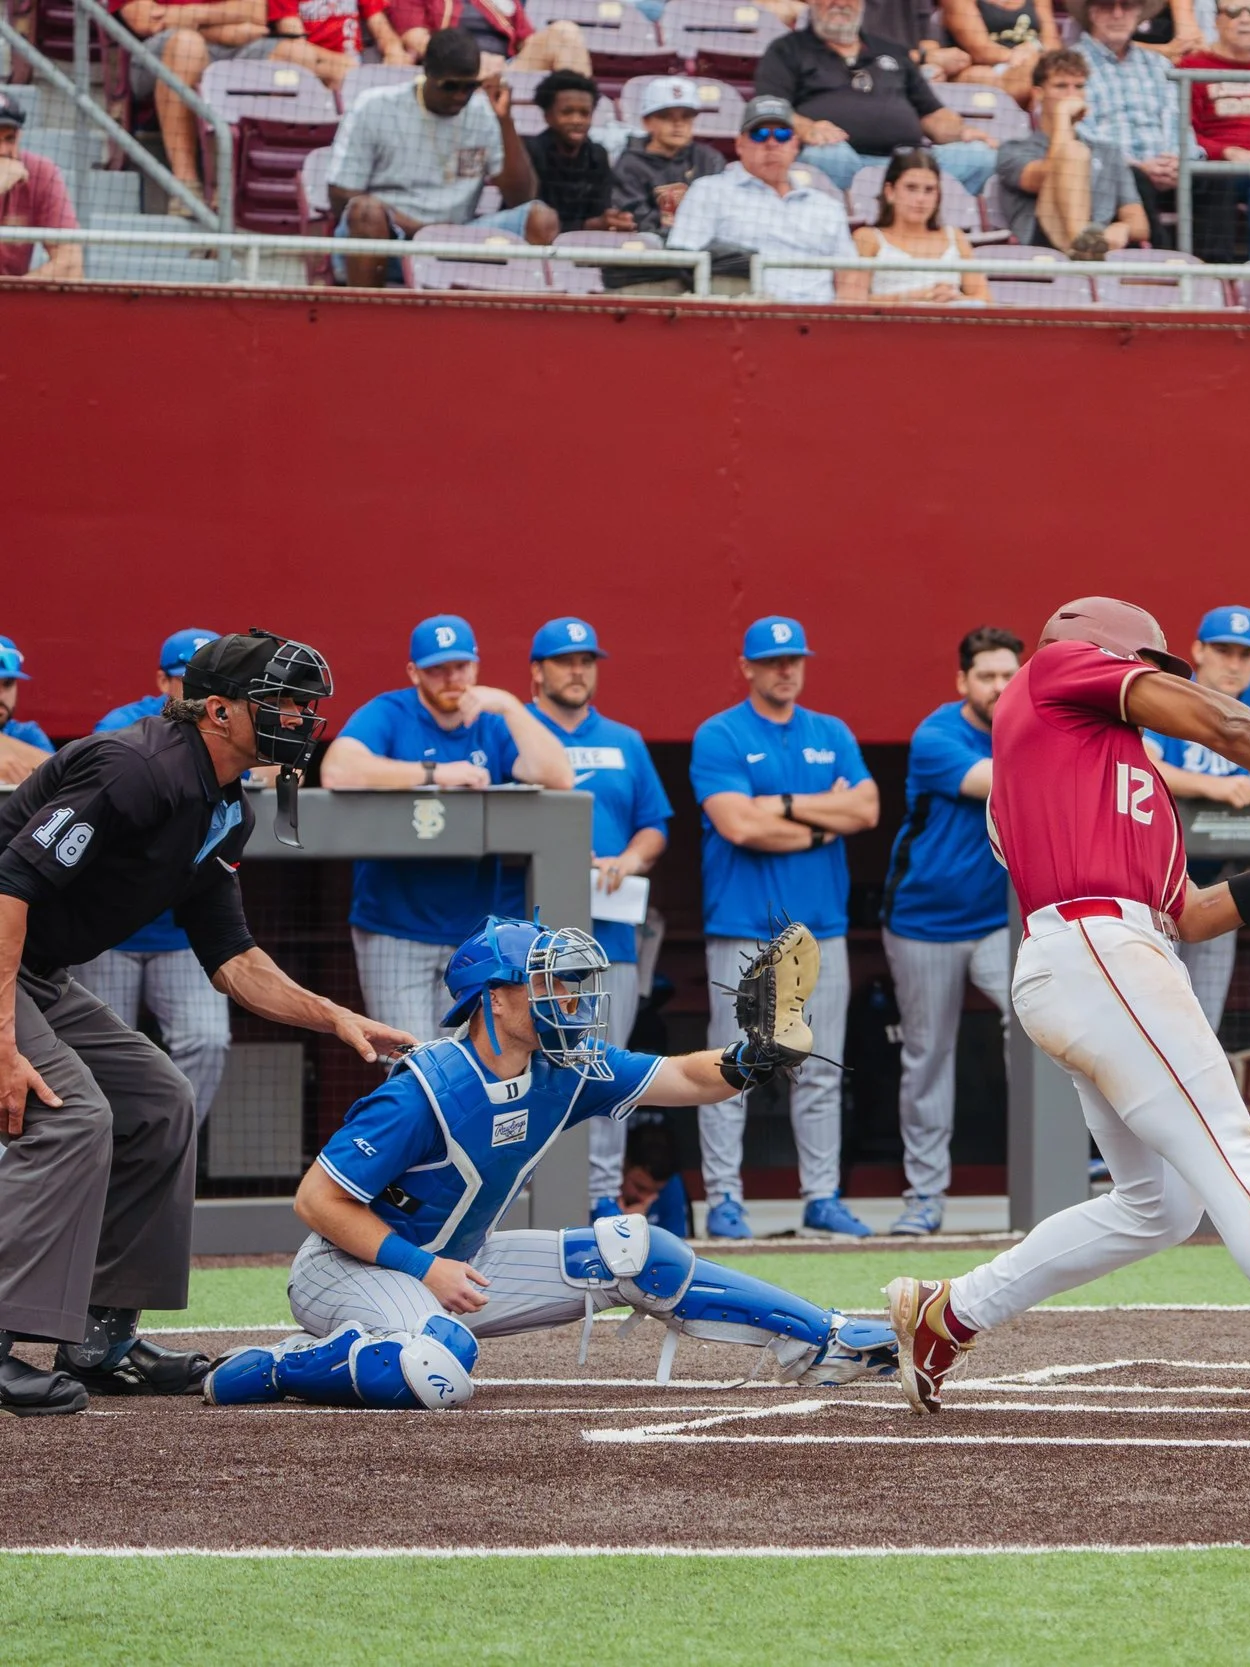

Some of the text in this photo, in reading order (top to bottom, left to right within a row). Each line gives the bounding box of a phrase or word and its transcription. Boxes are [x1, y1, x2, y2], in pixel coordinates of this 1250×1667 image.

[1116, 760, 1154, 826] 12
[32, 807, 95, 867] 18
[353, 1137, 378, 1157] ACC
